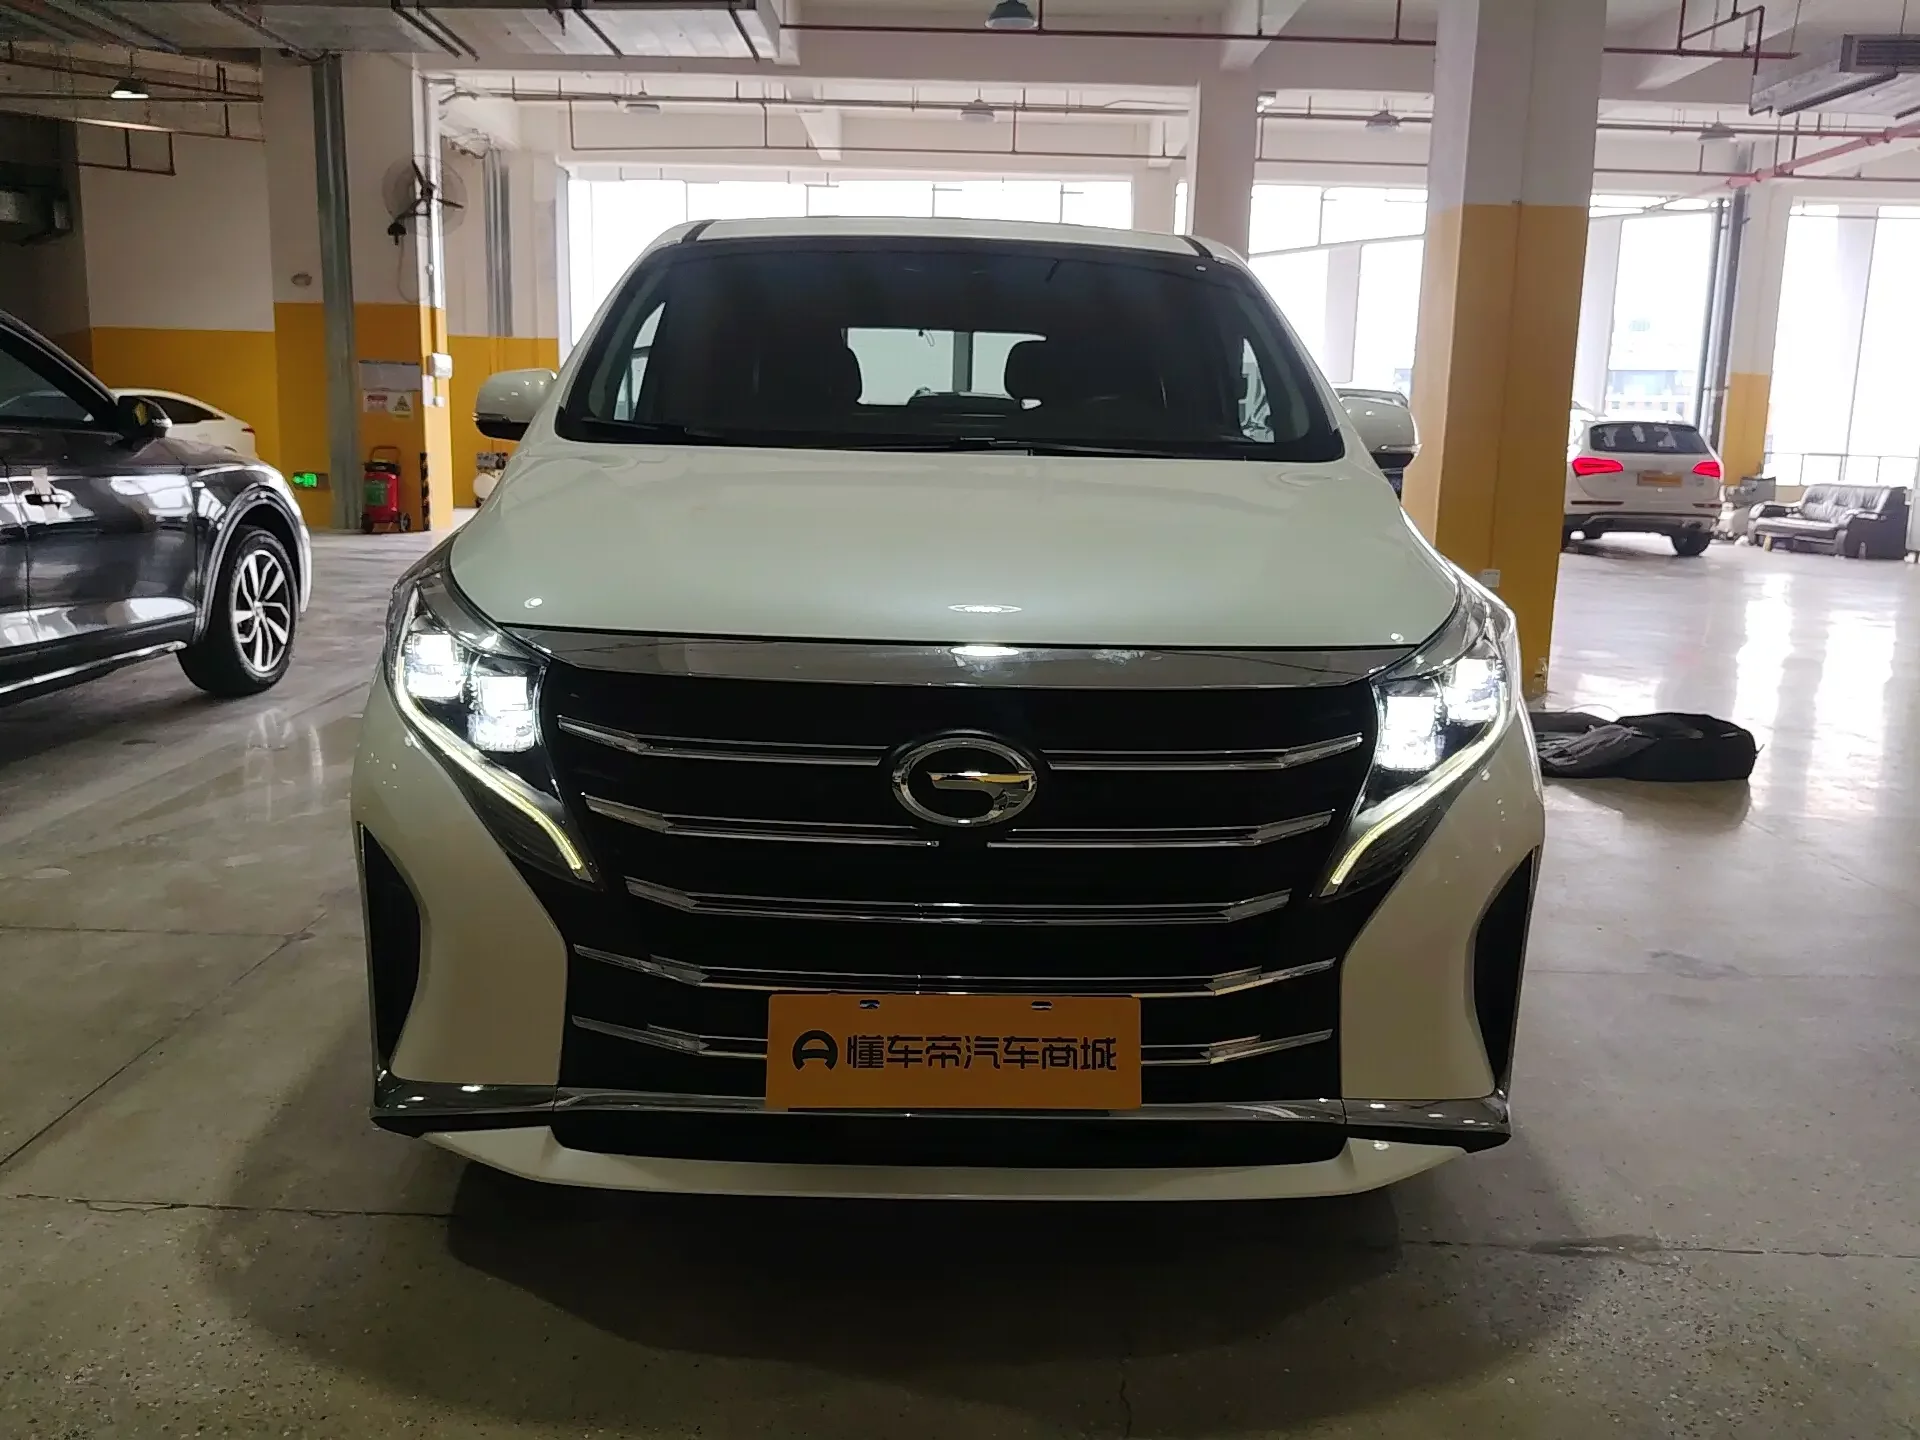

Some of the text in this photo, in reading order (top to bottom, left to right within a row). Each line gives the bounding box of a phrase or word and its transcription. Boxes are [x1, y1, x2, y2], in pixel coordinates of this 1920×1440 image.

[846, 1034, 1117, 1070] 懂车帝汽车商城
